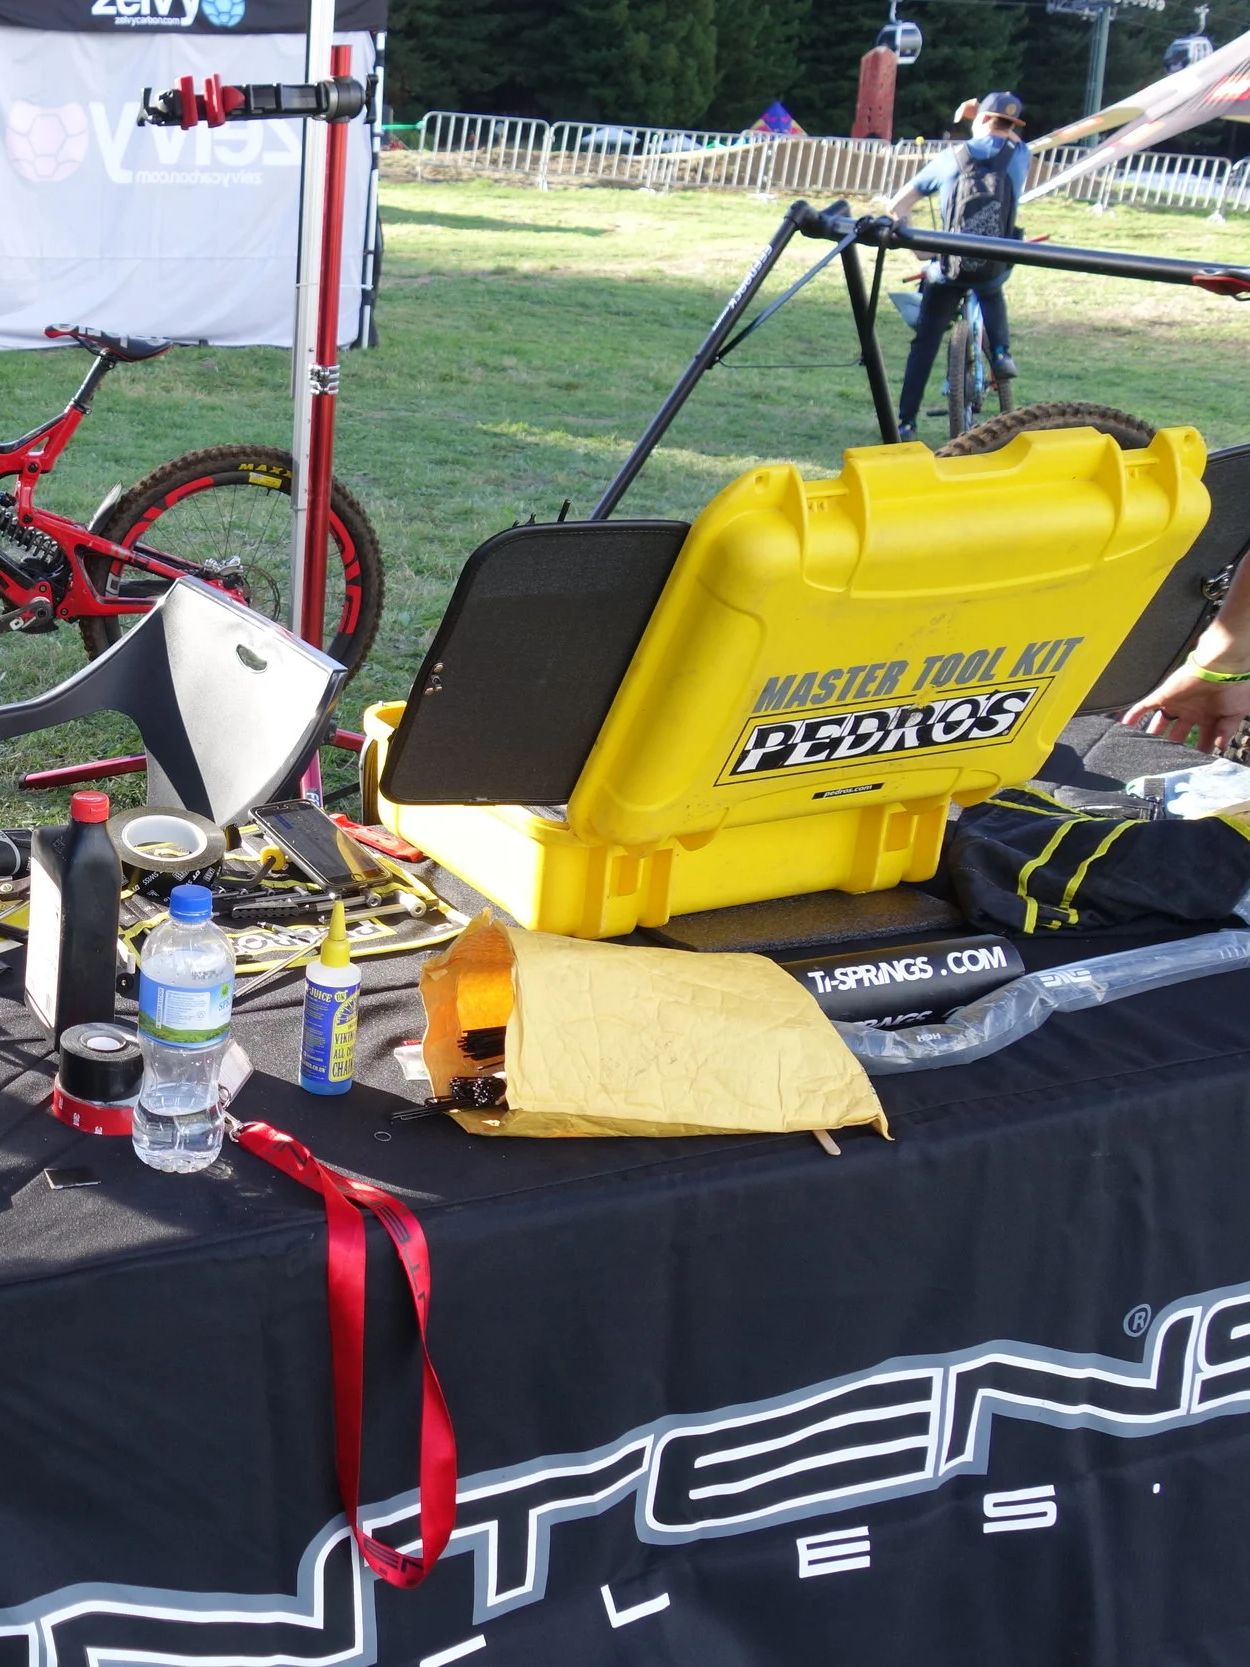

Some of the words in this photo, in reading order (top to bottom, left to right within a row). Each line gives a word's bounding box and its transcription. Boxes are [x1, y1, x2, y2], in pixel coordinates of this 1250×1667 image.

[751, 660, 909, 713] MASTER
[912, 646, 1006, 691] TOOL
[1008, 636, 1085, 678] KIT
[823, 784, 874, 798] pedros.com
